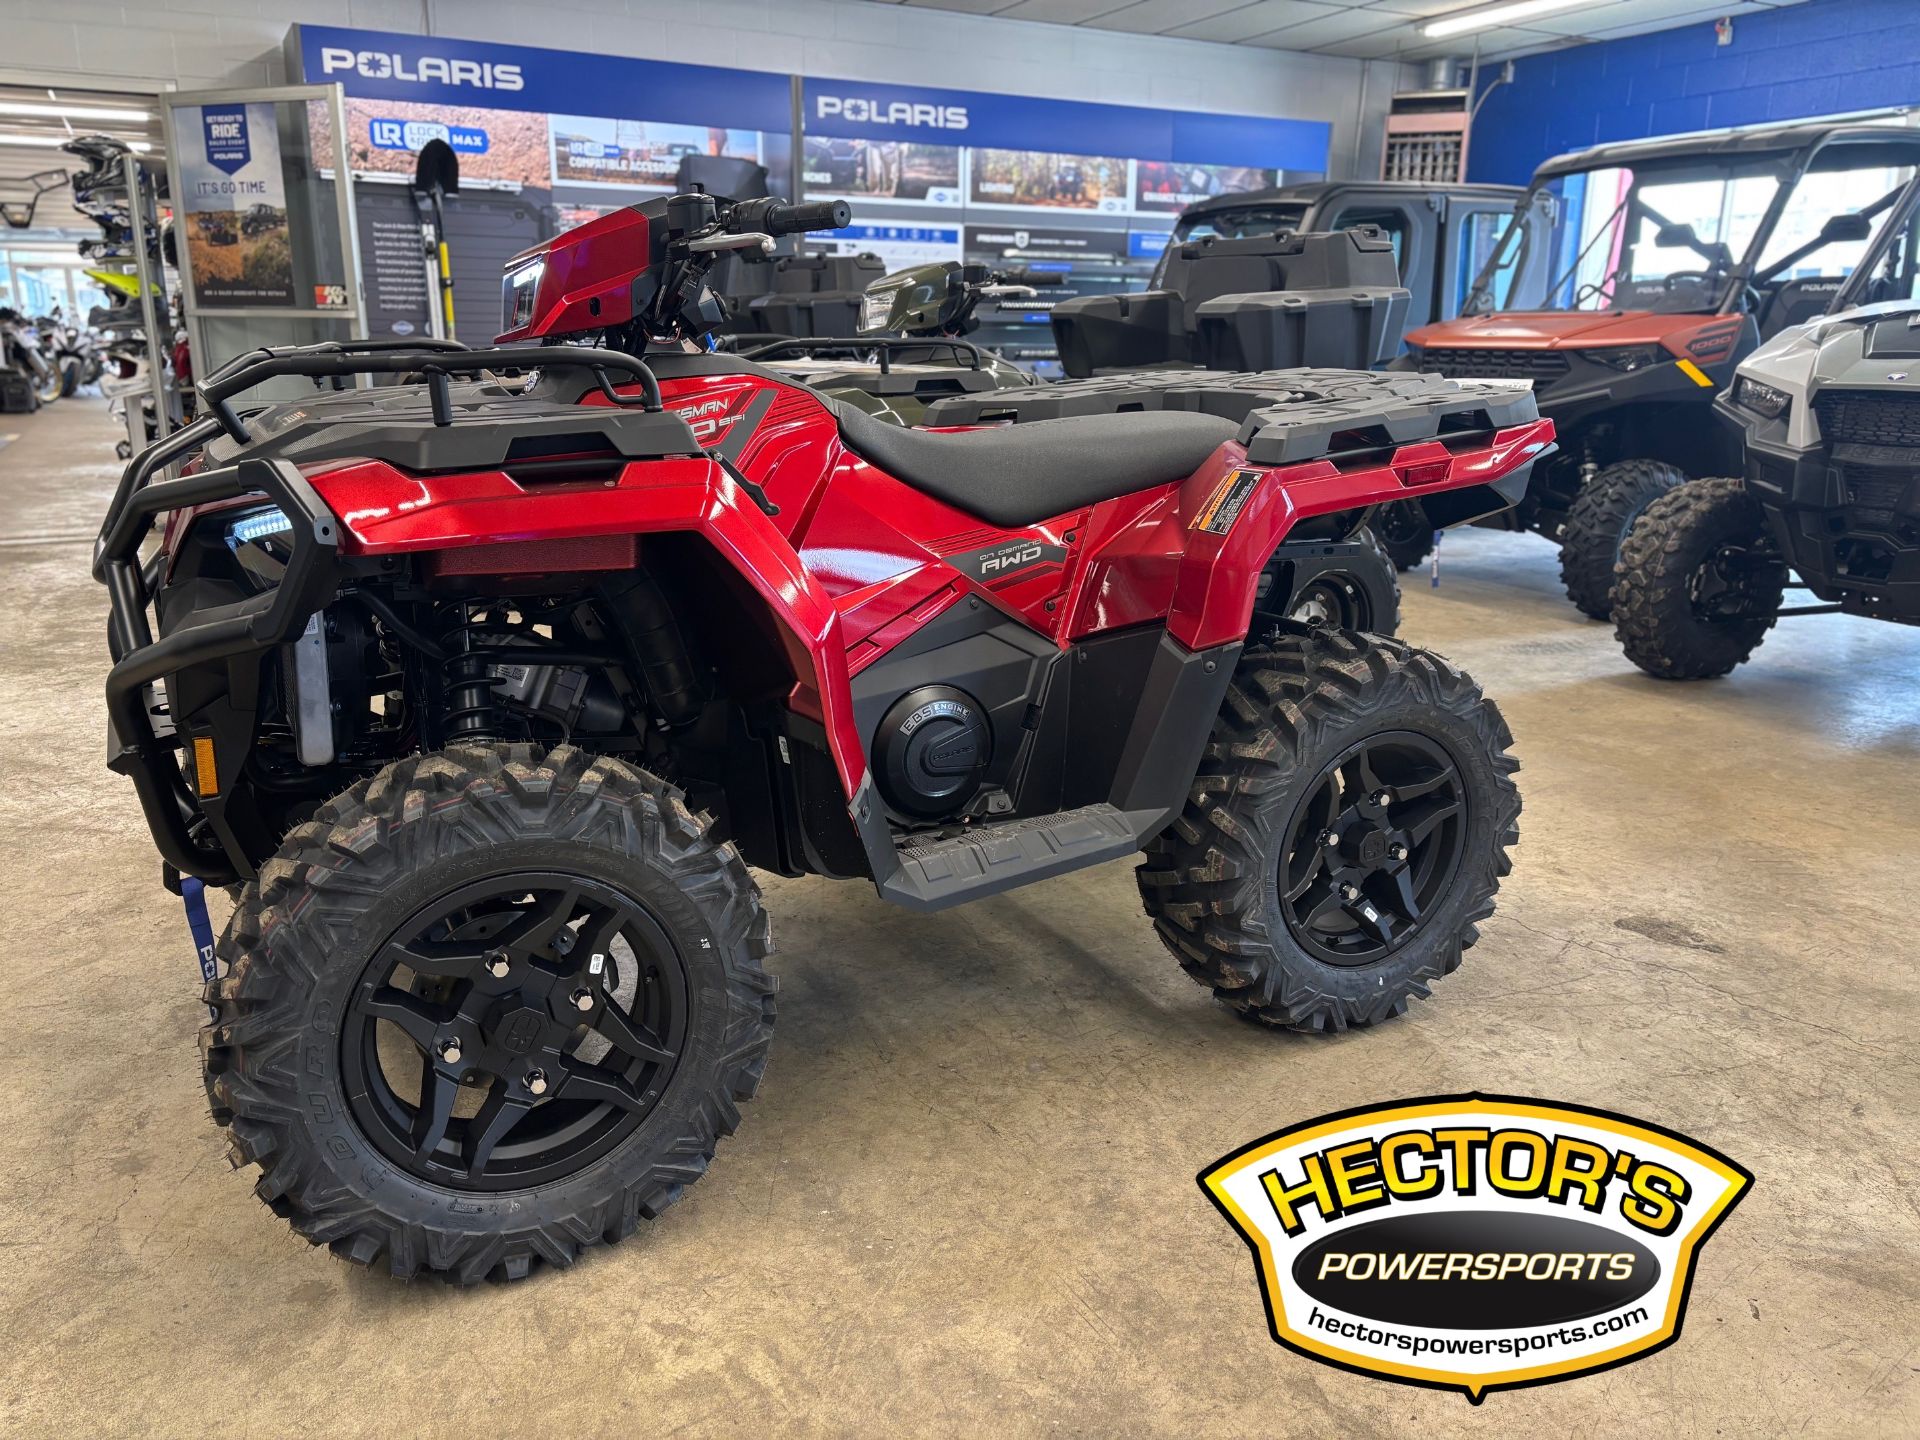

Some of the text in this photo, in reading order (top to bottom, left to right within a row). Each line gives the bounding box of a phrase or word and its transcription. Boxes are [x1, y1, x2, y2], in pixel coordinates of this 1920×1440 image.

[321, 47, 524, 91] POLARIS
[817, 95, 969, 129] POLARIS
[211, 123, 241, 139] RIDE
[373, 121, 403, 147] LR
[408, 125, 445, 138] LOCK
[451, 133, 483, 147] MAX
[213, 152, 244, 160] POLARIS
[568, 156, 681, 174] COMPATIBLE ACCESSOR
[802, 172, 832, 184] NCHES
[197, 180, 266, 195] IT'S GO TIME
[1690, 335, 1733, 351] 1000
[979, 539, 1042, 560] ON DEMAND
[981, 546, 1042, 575] AWD
[903, 706, 932, 732] EBS
[933, 702, 970, 717] ENGINE
